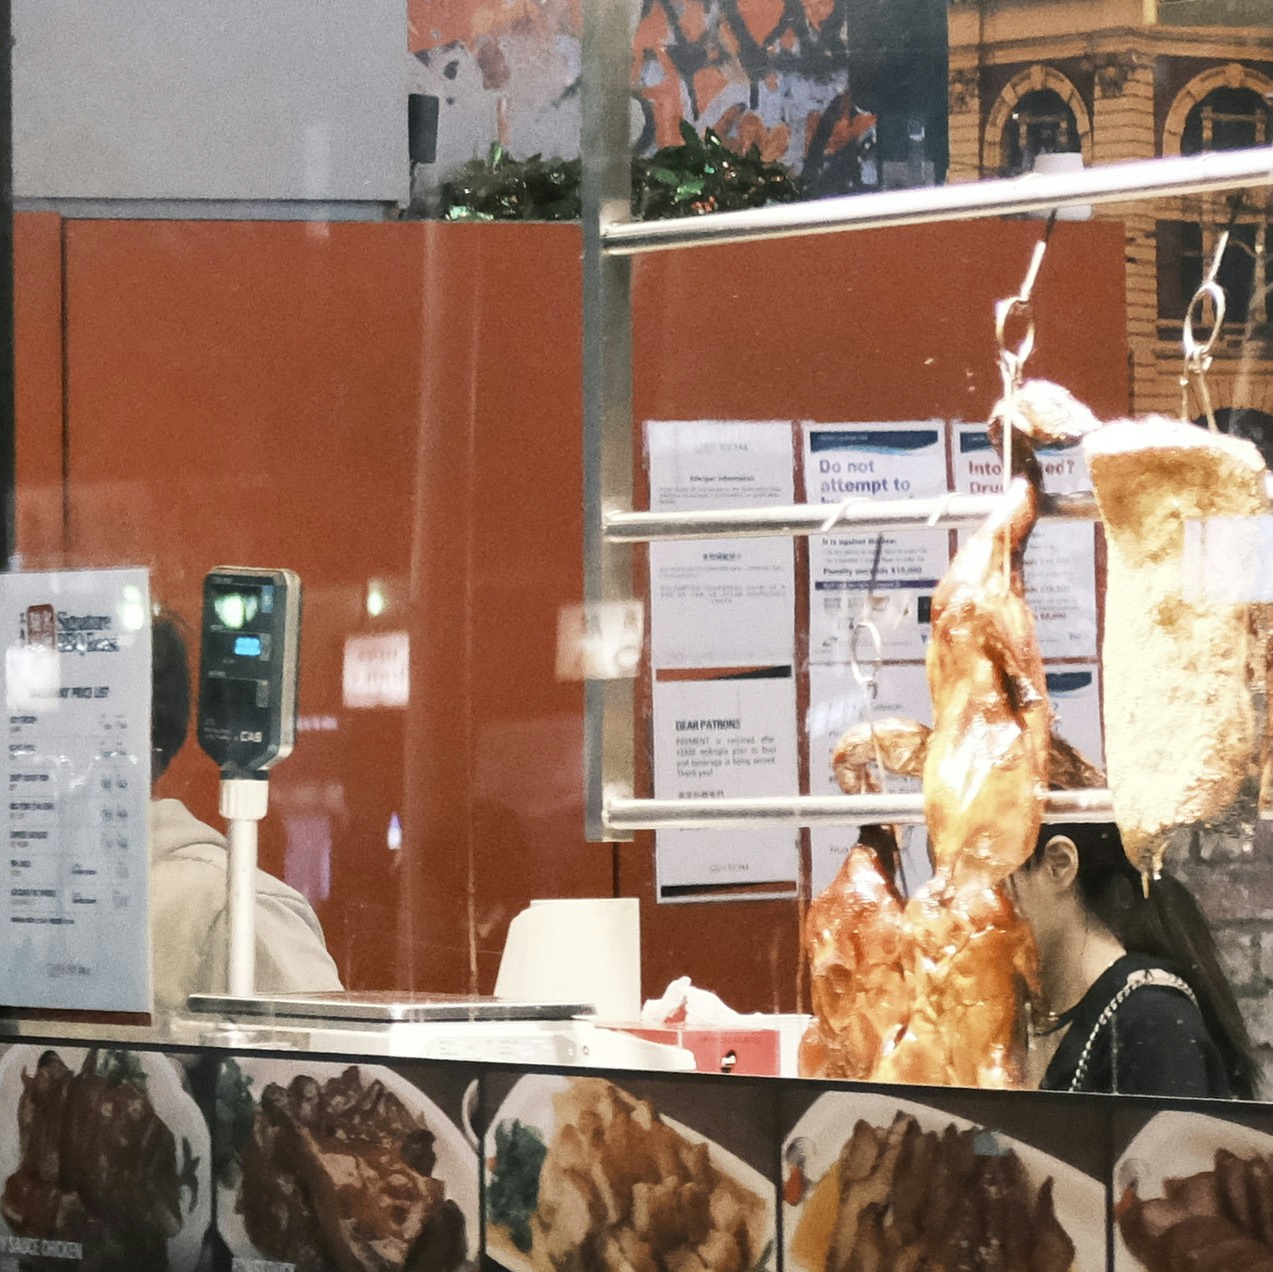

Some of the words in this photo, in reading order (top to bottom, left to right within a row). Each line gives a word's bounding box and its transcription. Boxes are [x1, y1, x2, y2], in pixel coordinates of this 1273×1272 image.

[819, 459, 841, 475] Do
[847, 459, 875, 474] not
[968, 459, 1075, 476] Intoed?
[821, 478, 888, 496] attempt
[893, 478, 911, 492] to
[675, 720, 699, 732] DEAR
[700, 719, 741, 731] PATRONS
